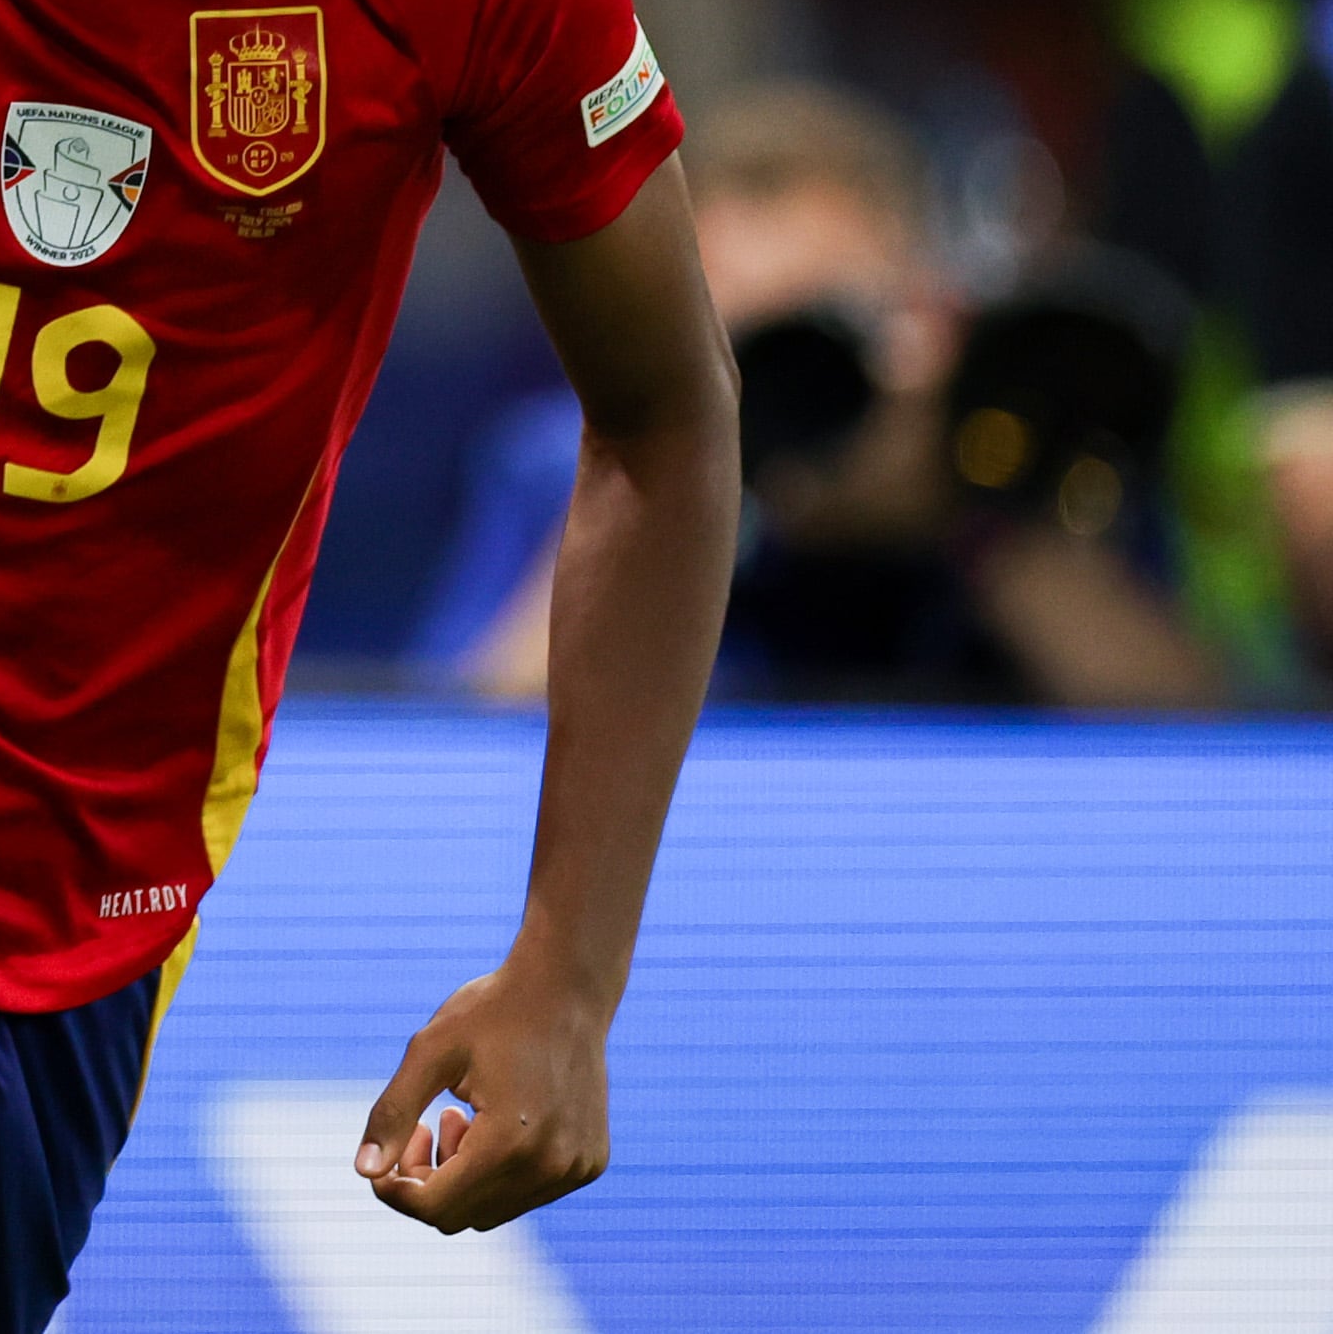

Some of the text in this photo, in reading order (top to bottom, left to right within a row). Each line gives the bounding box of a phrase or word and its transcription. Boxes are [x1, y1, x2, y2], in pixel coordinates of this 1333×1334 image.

[588, 78, 624, 110] UEFA
[16, 108, 145, 138] UEFA NATIONS LEAGUE
[25, 234, 96, 260] WINNER 2023
[99, 883, 188, 918] HEAT.RDY
